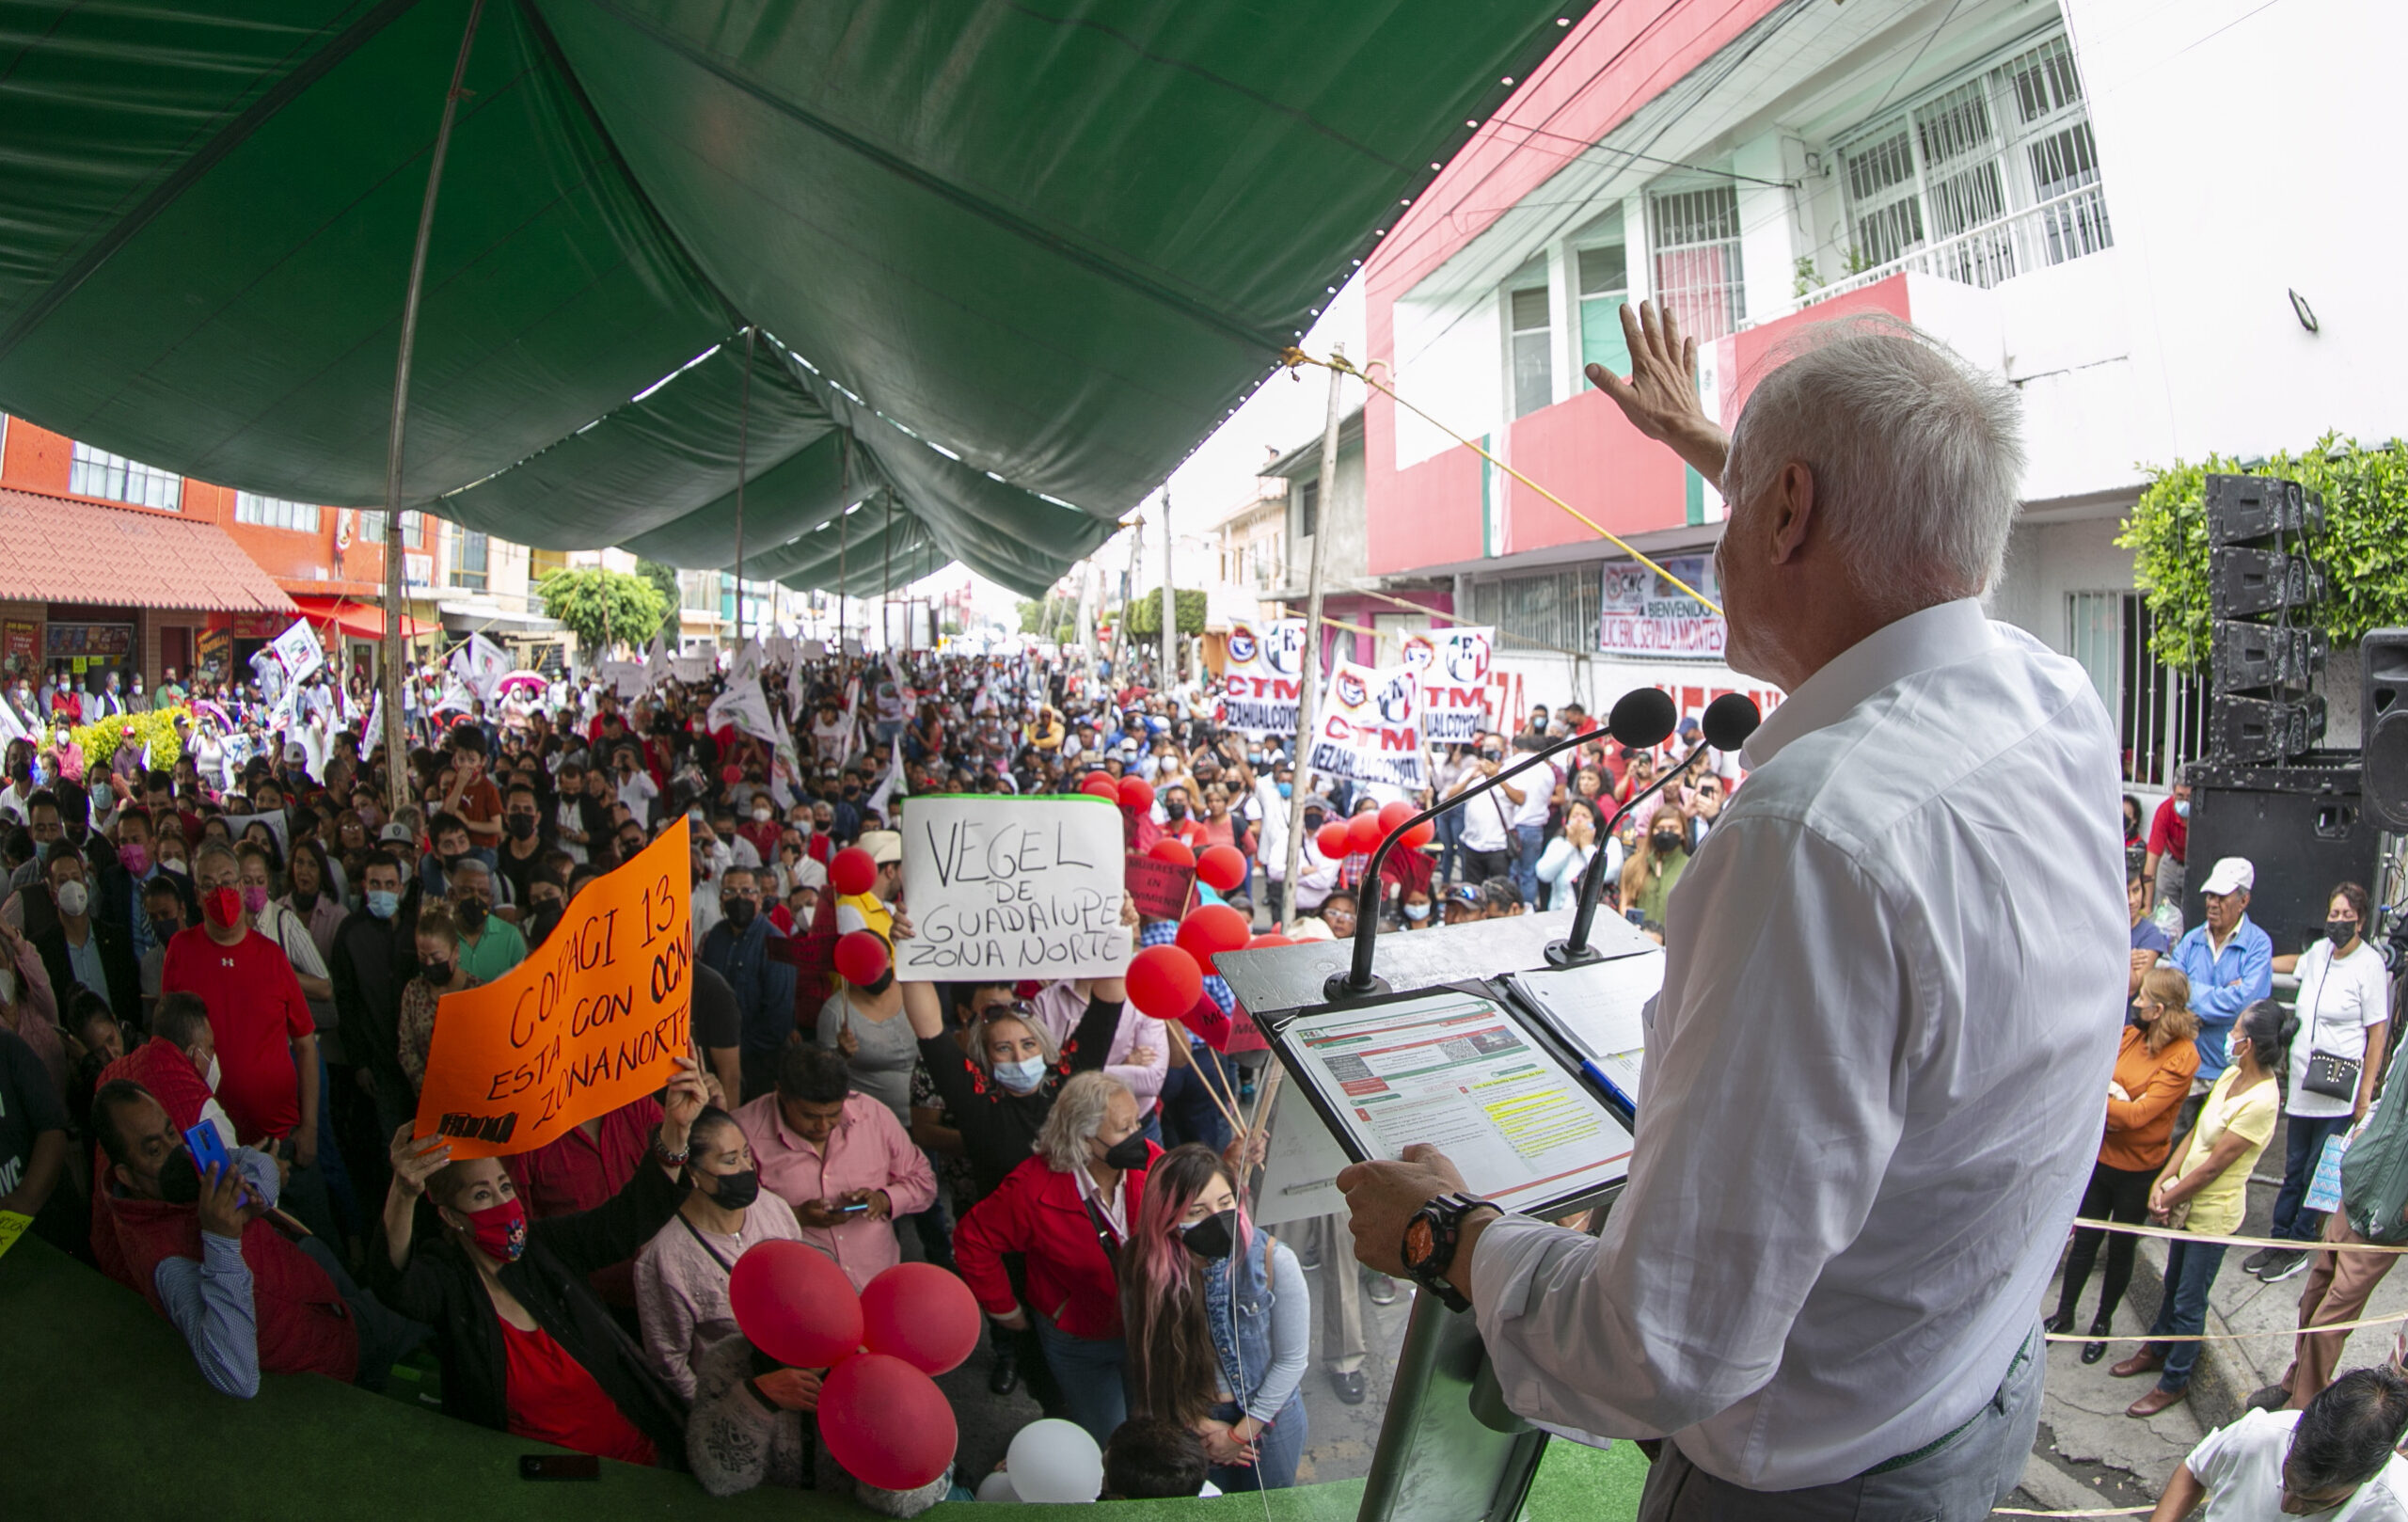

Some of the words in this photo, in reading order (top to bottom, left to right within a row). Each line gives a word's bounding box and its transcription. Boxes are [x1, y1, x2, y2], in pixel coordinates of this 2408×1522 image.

[1622, 574, 1645, 593] CNC
[1648, 601, 1712, 618] BIENVENIDO
[1602, 619, 1618, 647] LIC
[1619, 619, 1639, 648] ERIC
[1640, 619, 1675, 649] SEVILLA
[1677, 619, 1722, 651] MONTES
[1227, 674, 1302, 700] CTM
[1325, 714, 1416, 752] CTM
[926, 818, 1094, 888] VEGEL
[1129, 857, 1174, 875] MUJERES
[985, 880, 1033, 903] DE
[1147, 877, 1161, 888] EN
[1131, 889, 1183, 909] OVIMIENTO
[510, 907, 619, 1049] COPACI
[641, 874, 675, 948] 13
[909, 939, 1005, 968] ZONA
[1019, 930, 1123, 968] NORTE
[572, 984, 633, 1038] CON
